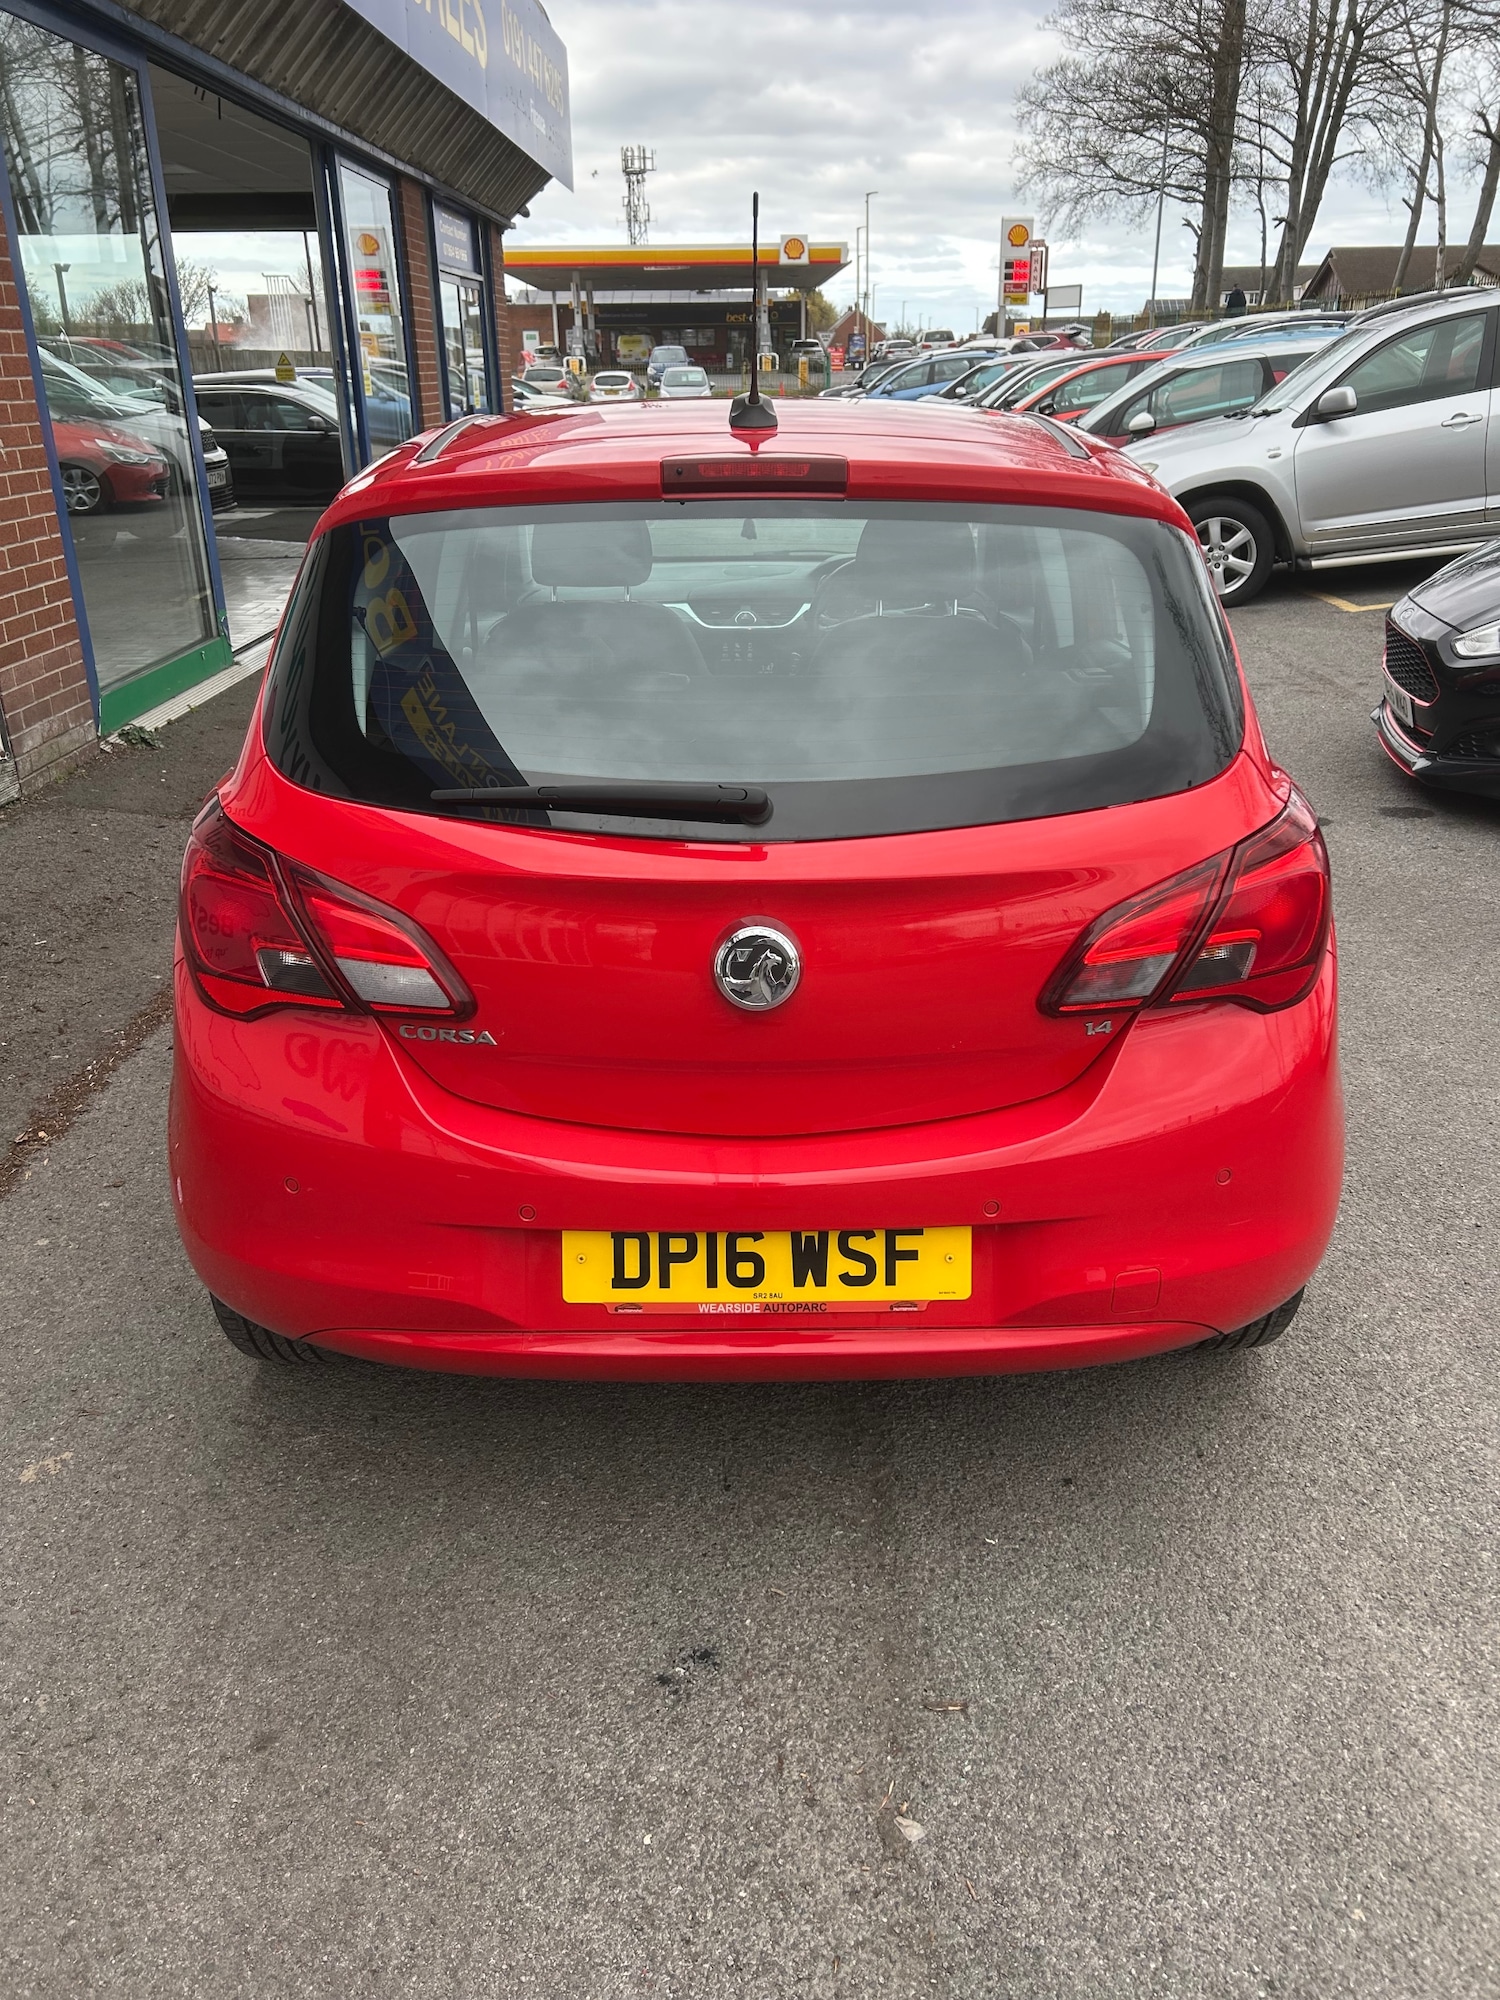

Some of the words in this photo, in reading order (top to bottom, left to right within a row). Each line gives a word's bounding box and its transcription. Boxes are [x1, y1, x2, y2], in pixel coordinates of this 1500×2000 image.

[399, 1023, 498, 1046] CORSA
[611, 1232, 766, 1289] DP16
[790, 1228, 925, 1288] WSF
[753, 1292, 768, 1300] SR2
[698, 1303, 761, 1313] WEARSIDE
[763, 1302, 828, 1313] AUTOPARC
